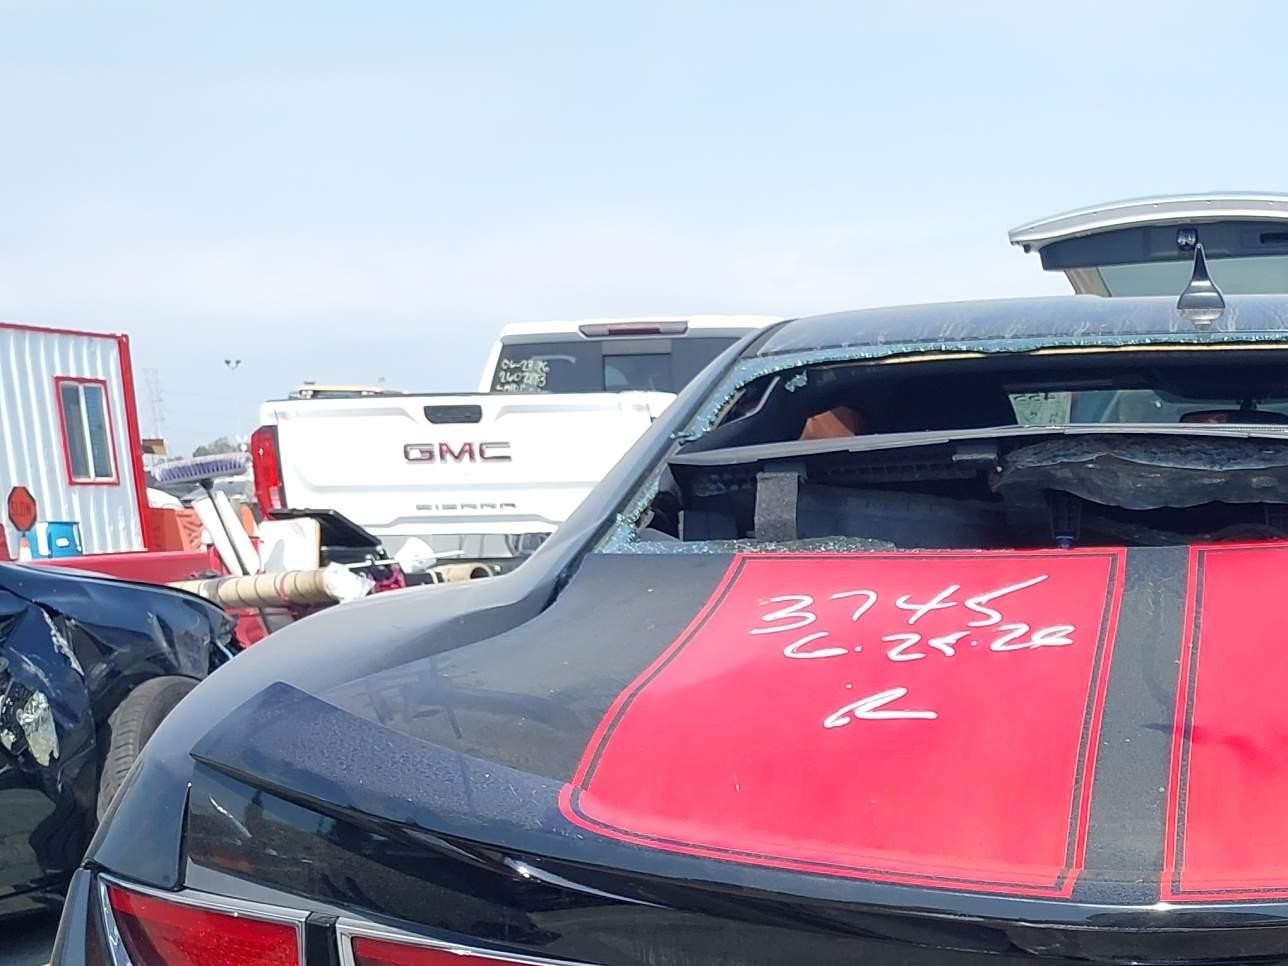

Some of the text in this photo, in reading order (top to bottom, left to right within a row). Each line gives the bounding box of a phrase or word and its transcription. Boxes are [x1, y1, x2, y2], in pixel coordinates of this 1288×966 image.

[403, 442, 512, 463] GMC
[416, 502, 517, 511] SIERRA
[748, 574, 1048, 635] 3745
